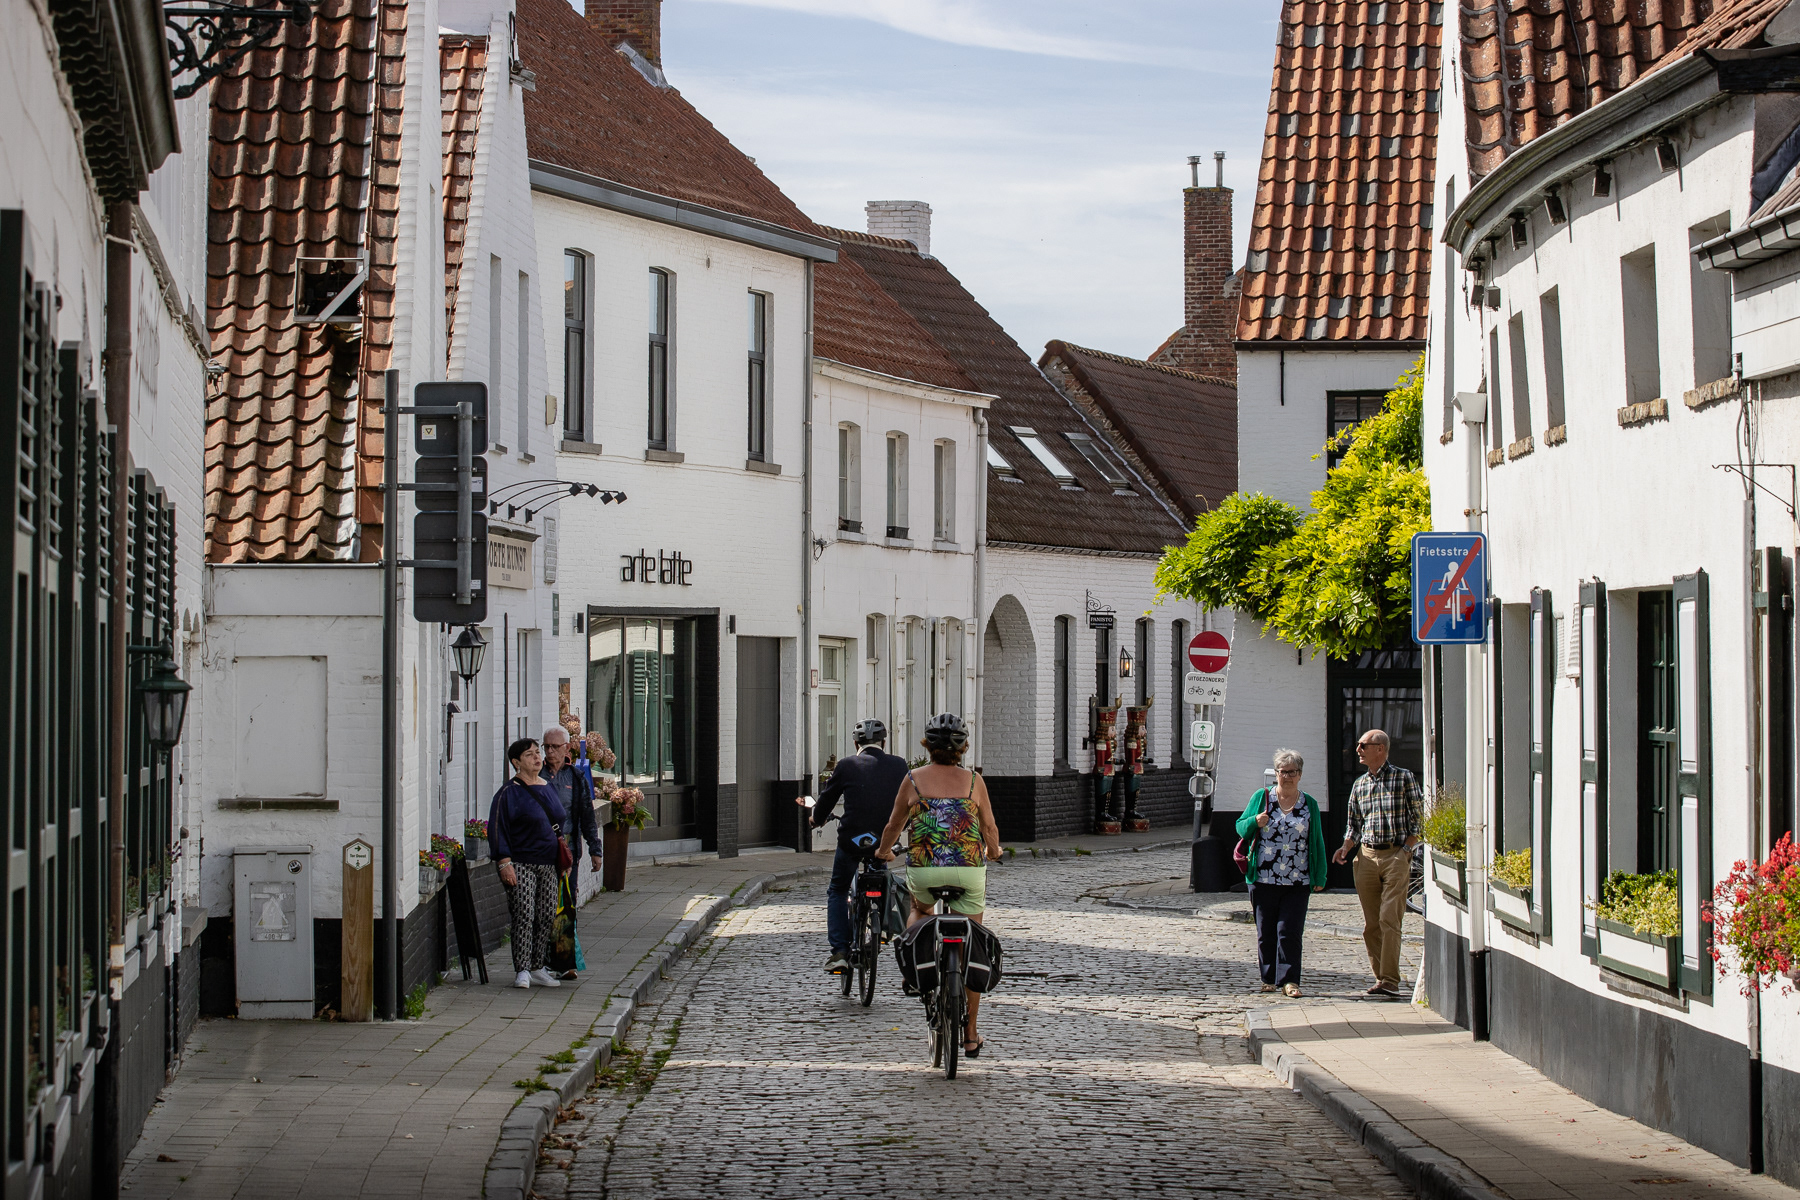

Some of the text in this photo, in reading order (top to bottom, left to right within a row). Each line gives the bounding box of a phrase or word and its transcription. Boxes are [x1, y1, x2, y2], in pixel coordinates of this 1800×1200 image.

[488, 540, 505, 568] OETE
[620, 548, 692, 586] arte latte
